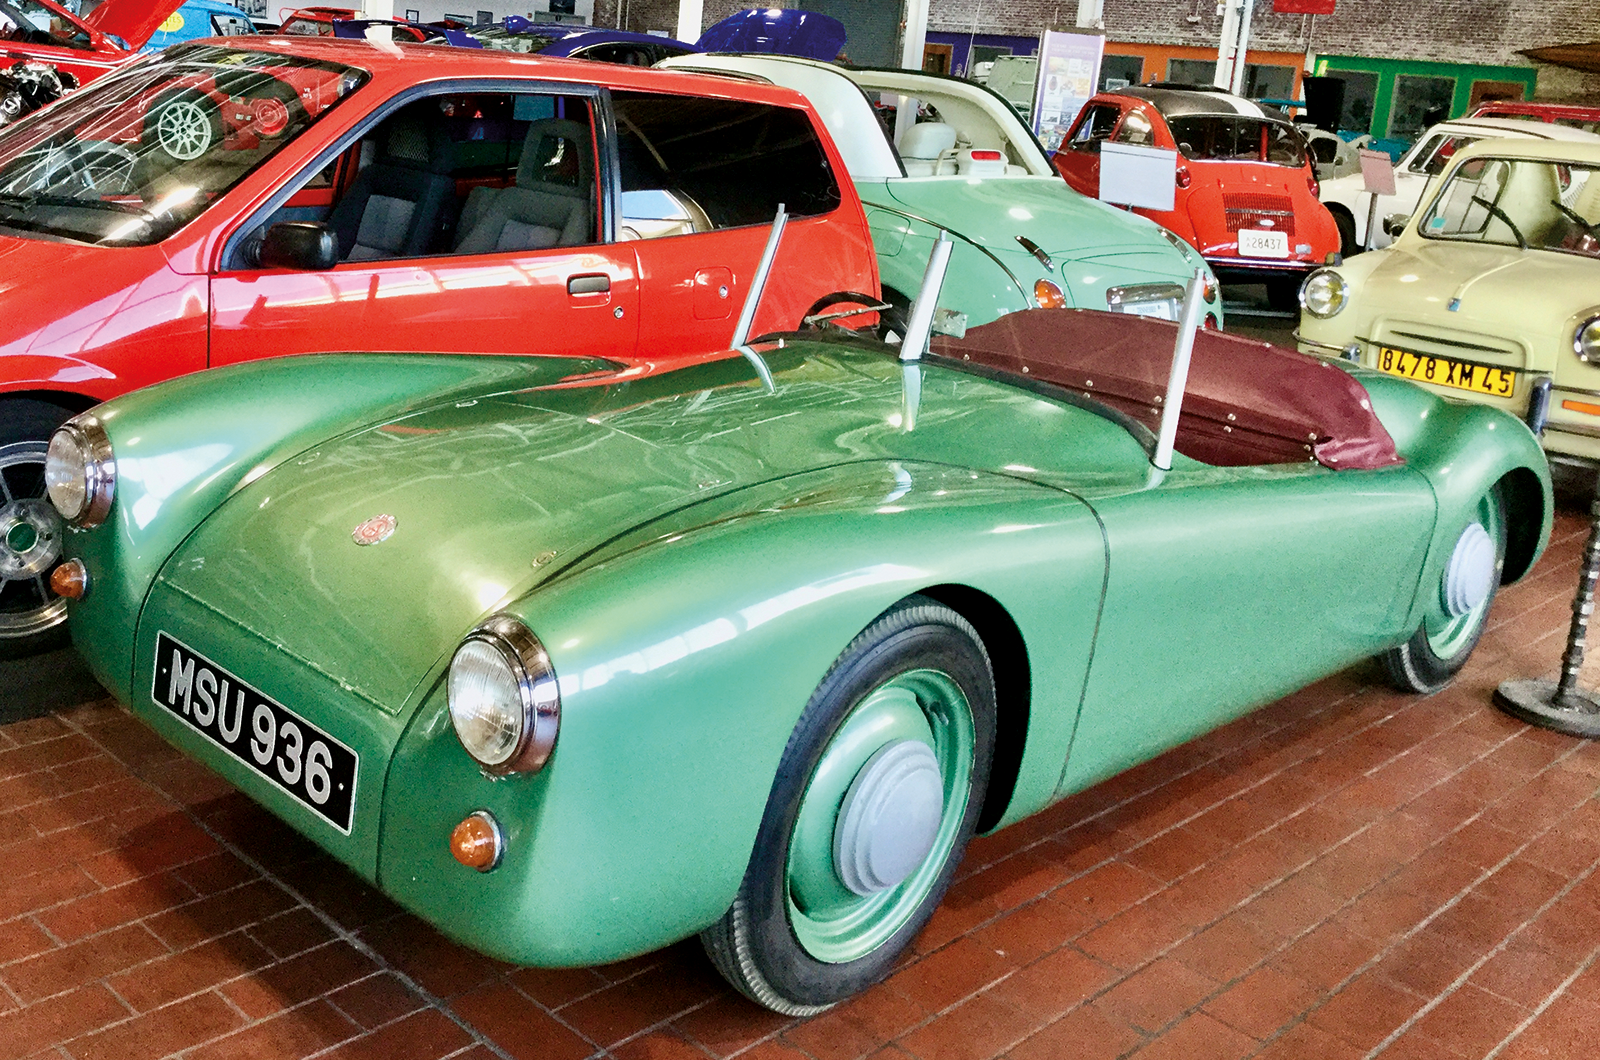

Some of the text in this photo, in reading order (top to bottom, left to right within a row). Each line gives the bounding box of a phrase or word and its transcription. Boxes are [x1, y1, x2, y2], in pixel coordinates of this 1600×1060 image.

[1251, 237, 1282, 250] 28437
[1382, 349, 1510, 394] 8478 XM 45
[168, 648, 333, 805] MSU 936
